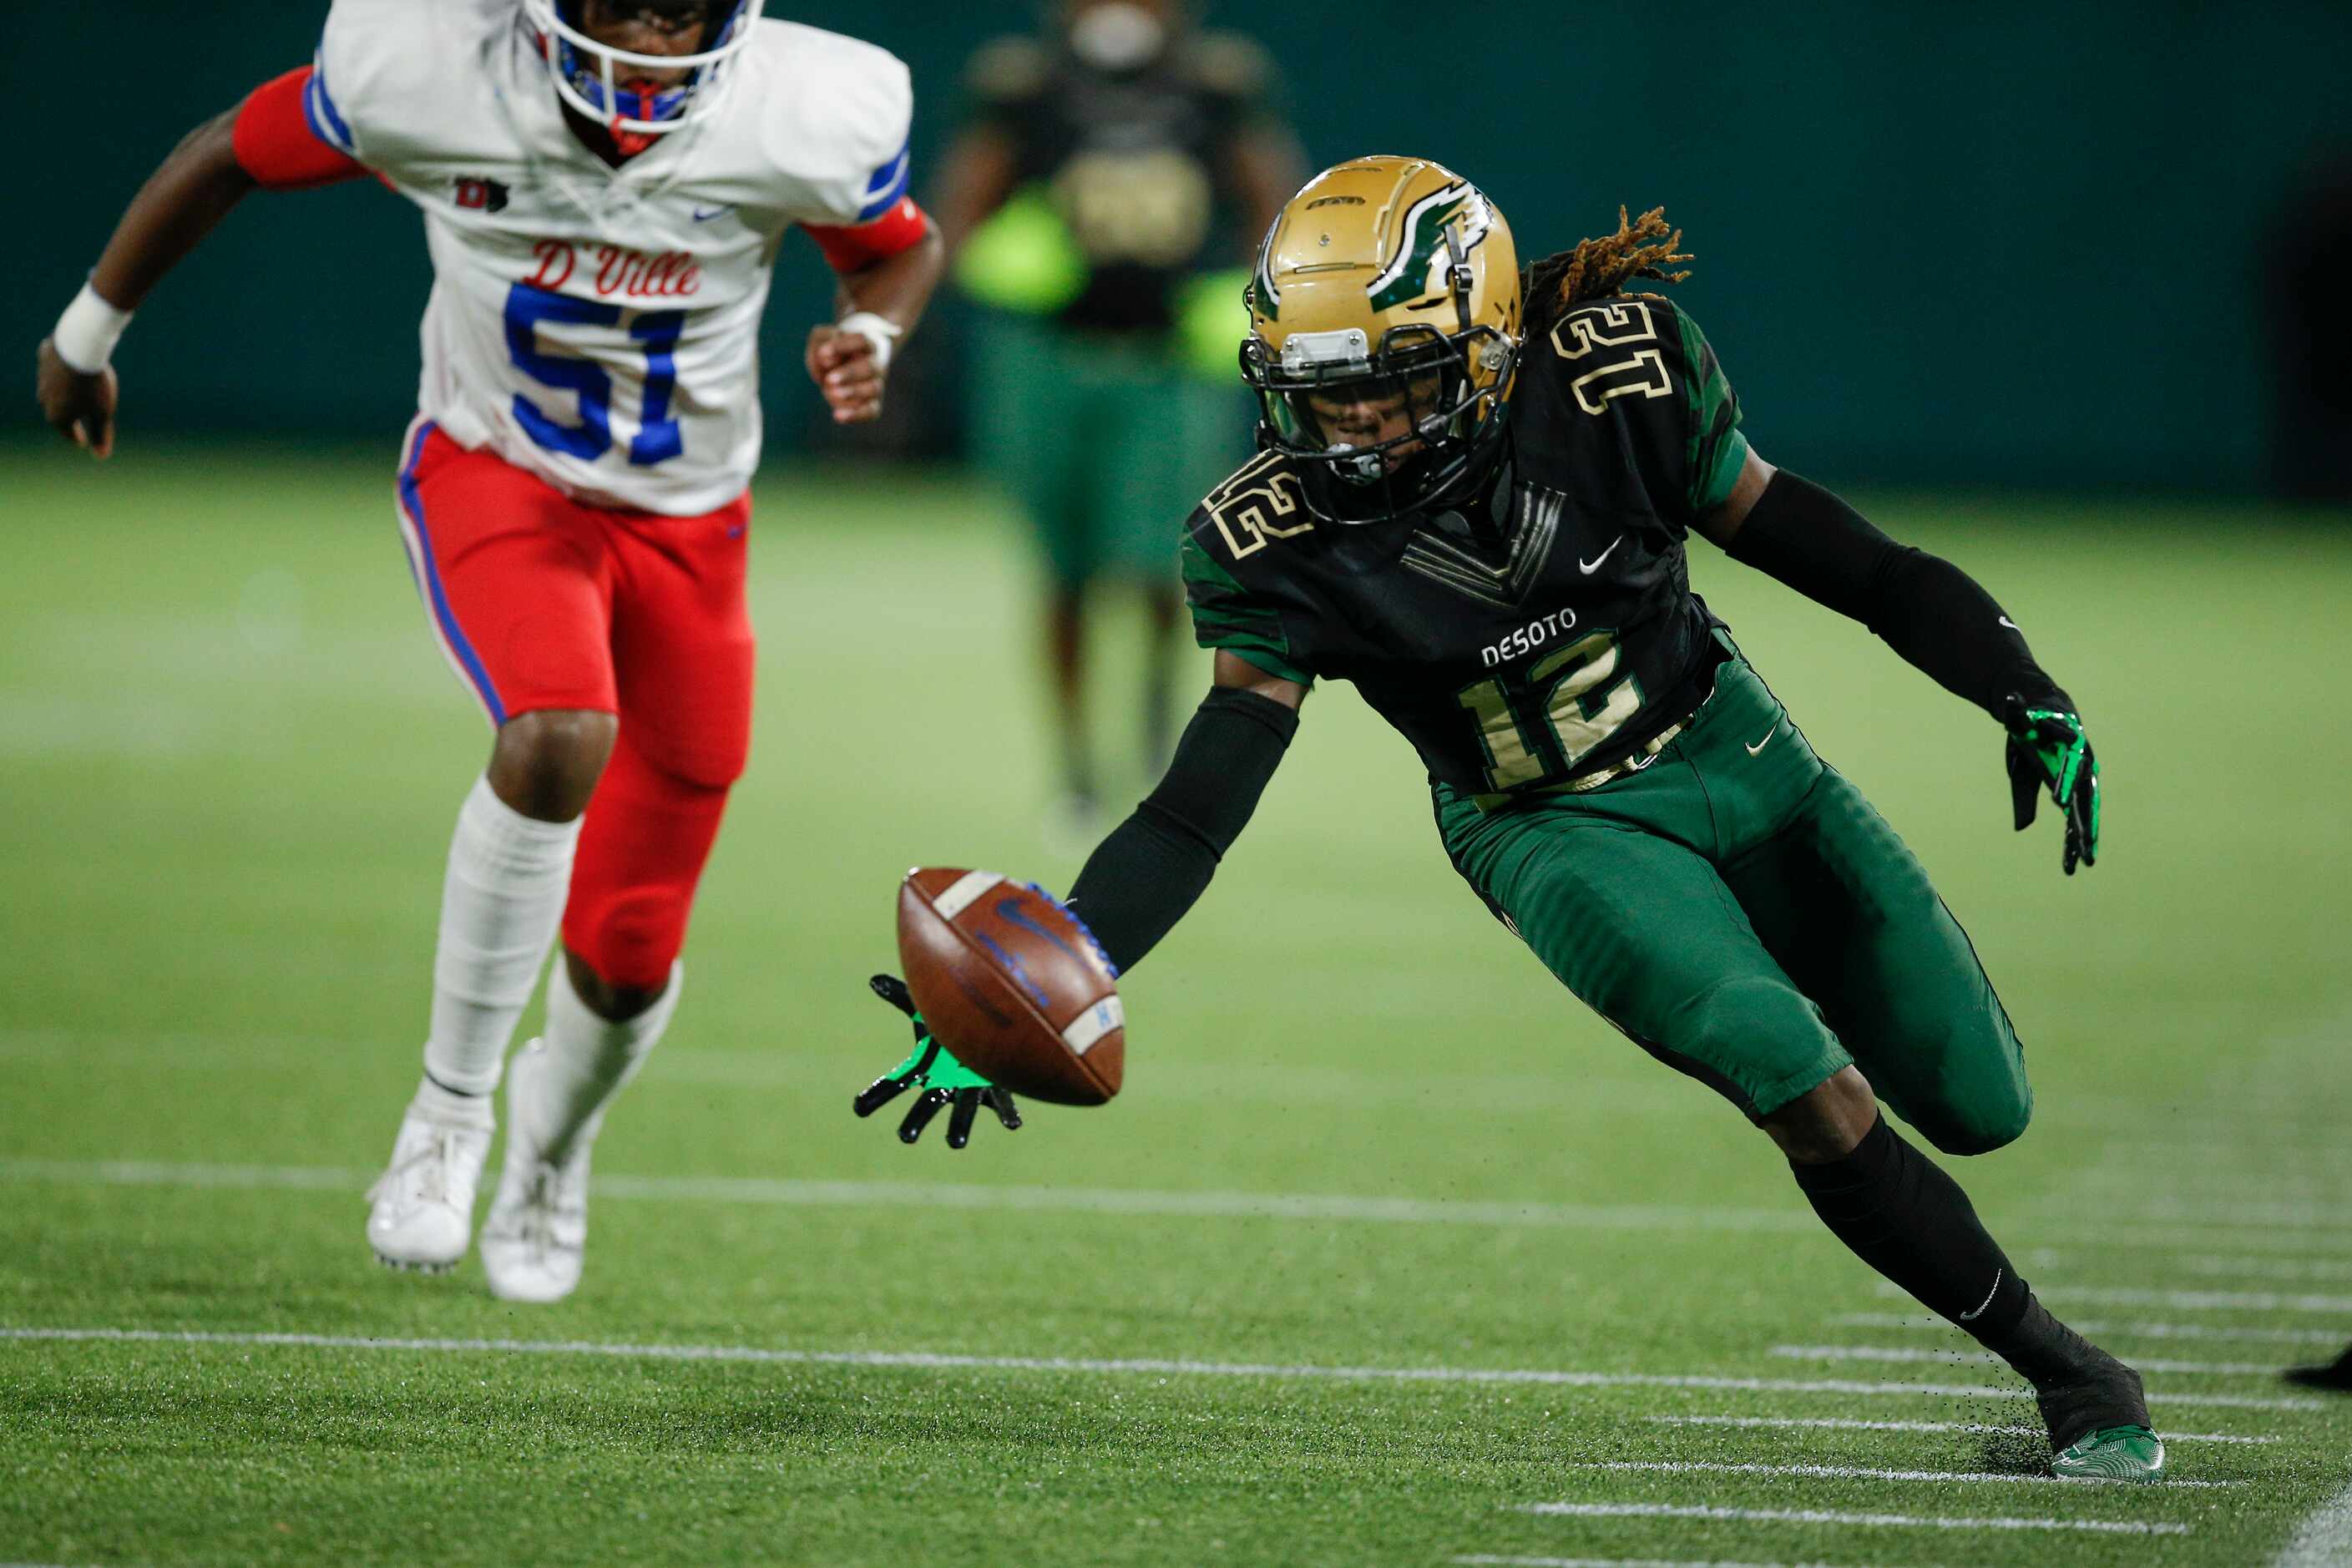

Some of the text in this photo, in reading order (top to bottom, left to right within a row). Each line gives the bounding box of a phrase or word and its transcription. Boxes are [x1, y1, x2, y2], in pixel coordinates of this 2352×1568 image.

[503, 282, 685, 466] 51
[1550, 302, 1672, 416] 12
[1481, 607, 1576, 667] DESOTO
[1458, 627, 1646, 793] 12
